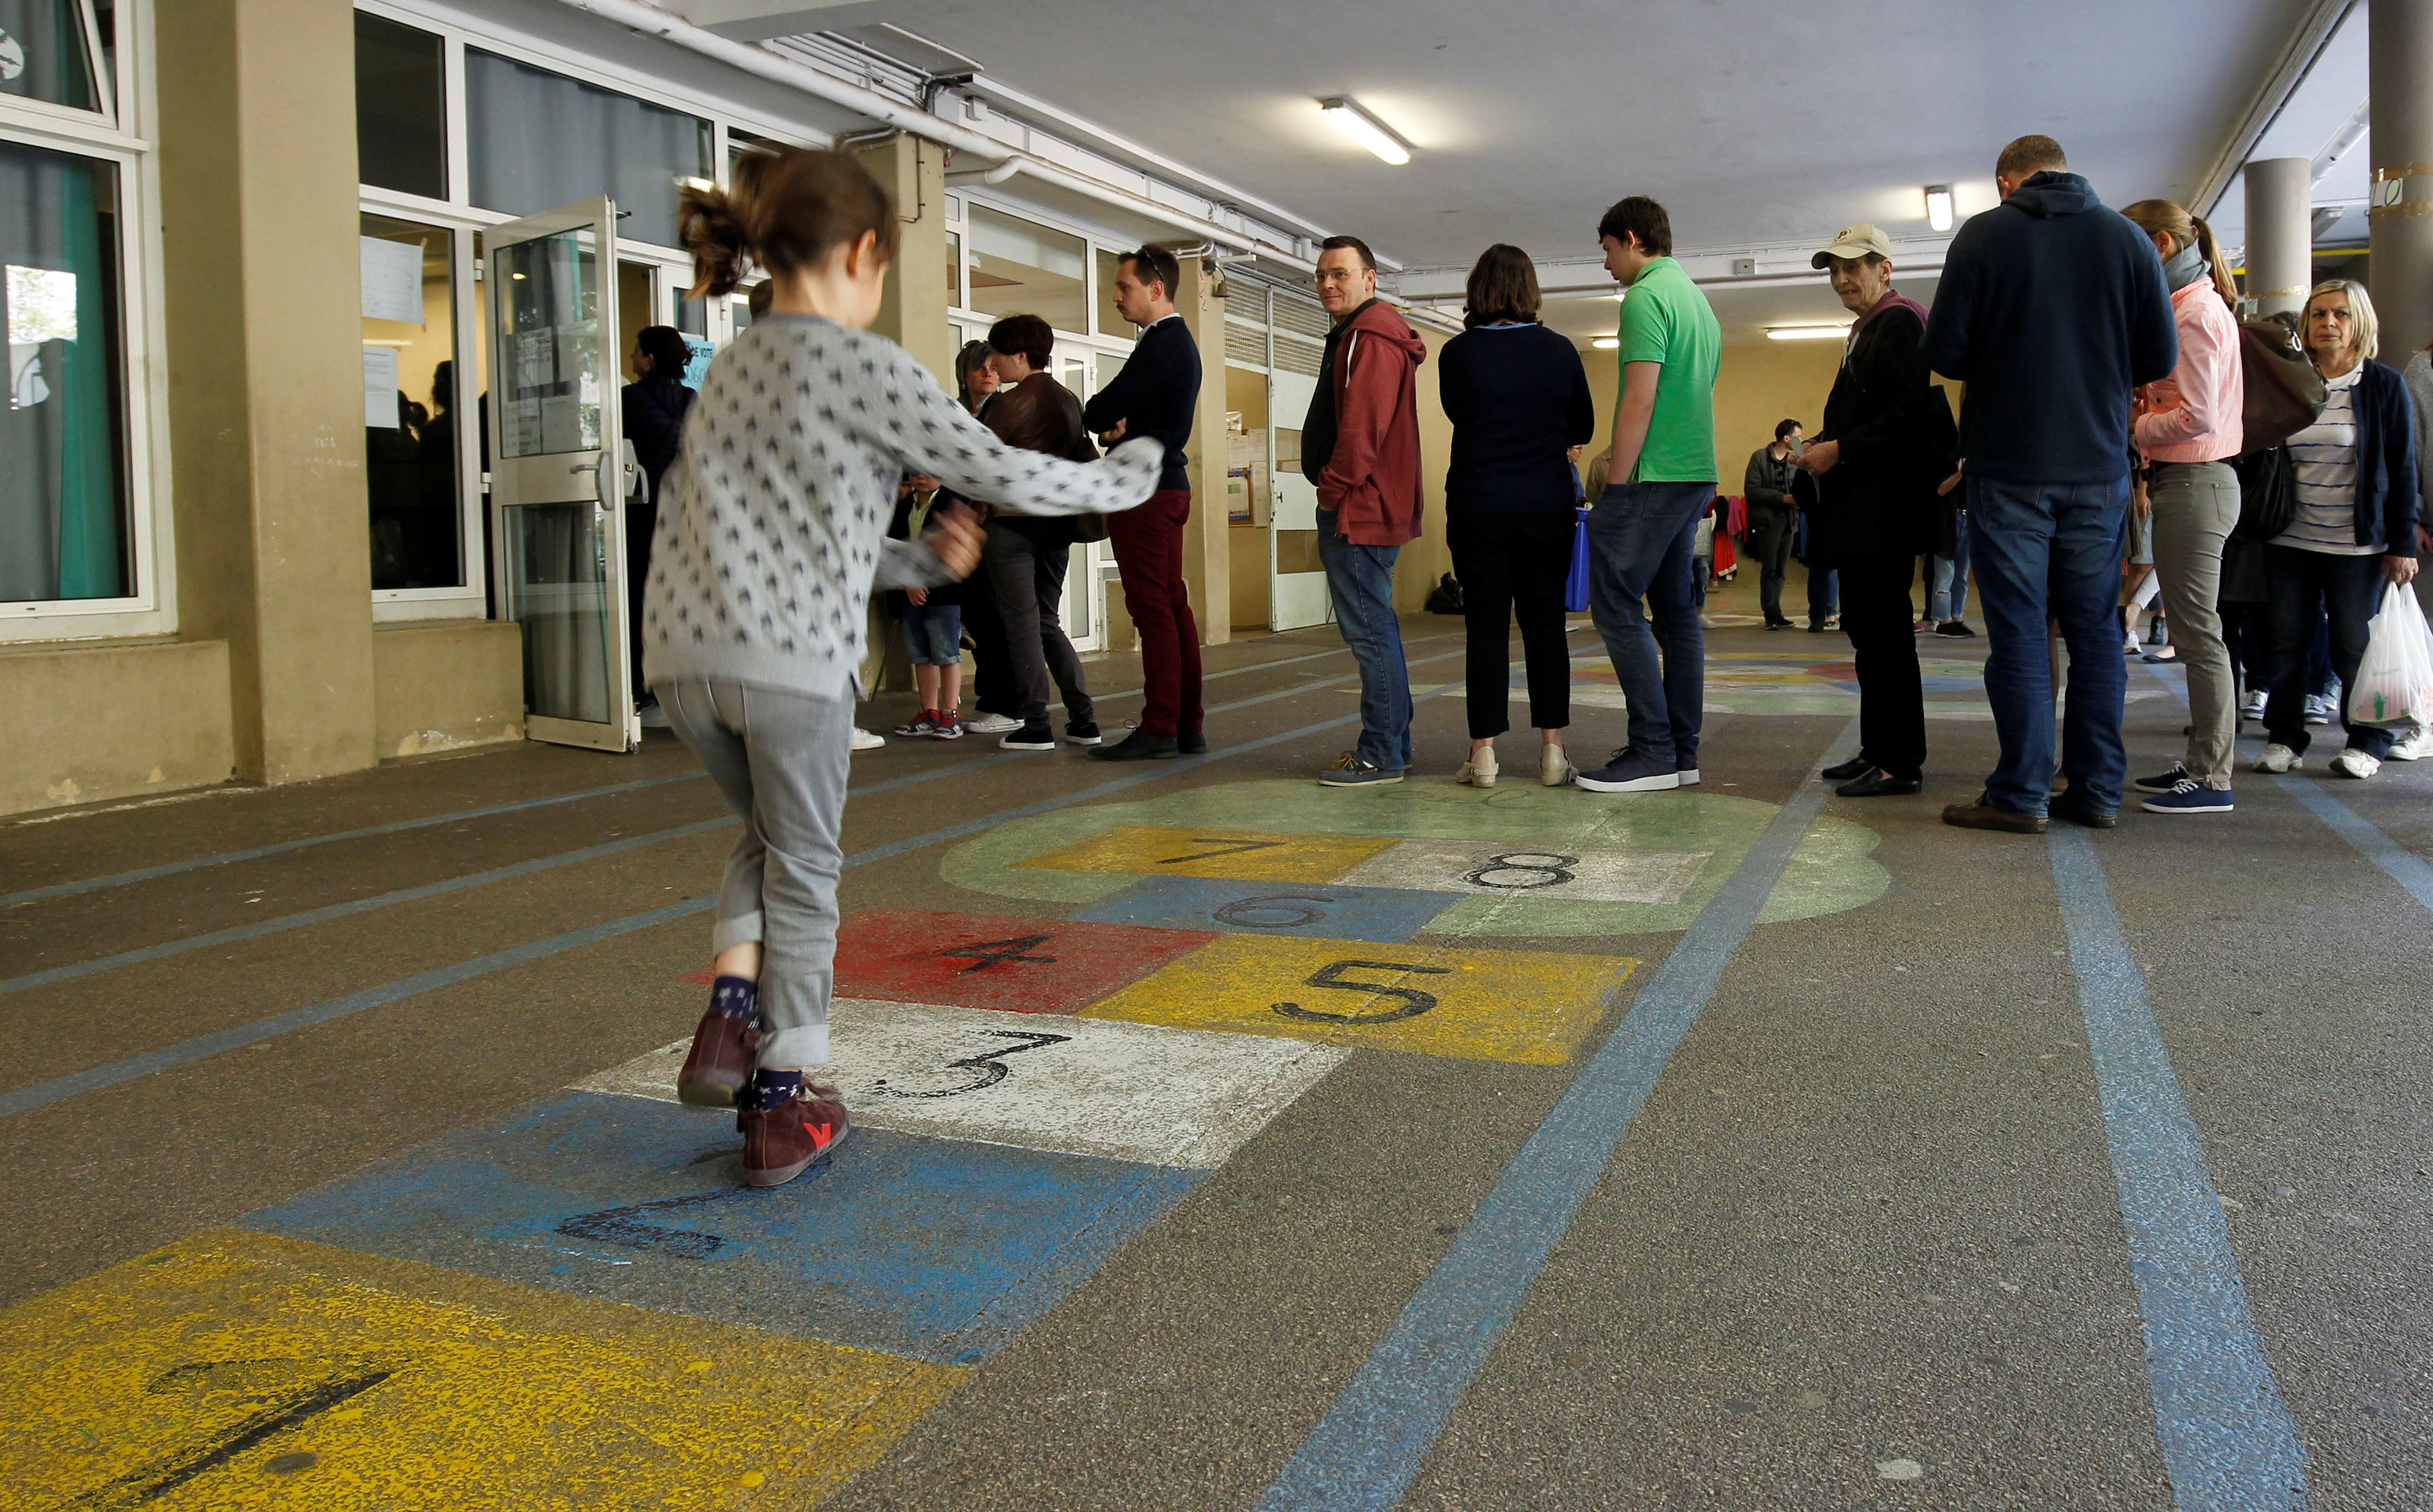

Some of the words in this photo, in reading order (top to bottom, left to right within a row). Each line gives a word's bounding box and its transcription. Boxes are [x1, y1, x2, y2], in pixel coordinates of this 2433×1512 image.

[699, 348, 713, 359] VOTE
[1156, 838, 1288, 864] 7
[1462, 852, 1579, 889] 8
[1212, 895, 1336, 928] 6
[942, 933, 1059, 977] 4
[1270, 959, 1451, 1025] 5
[869, 1027, 1073, 1098] 3
